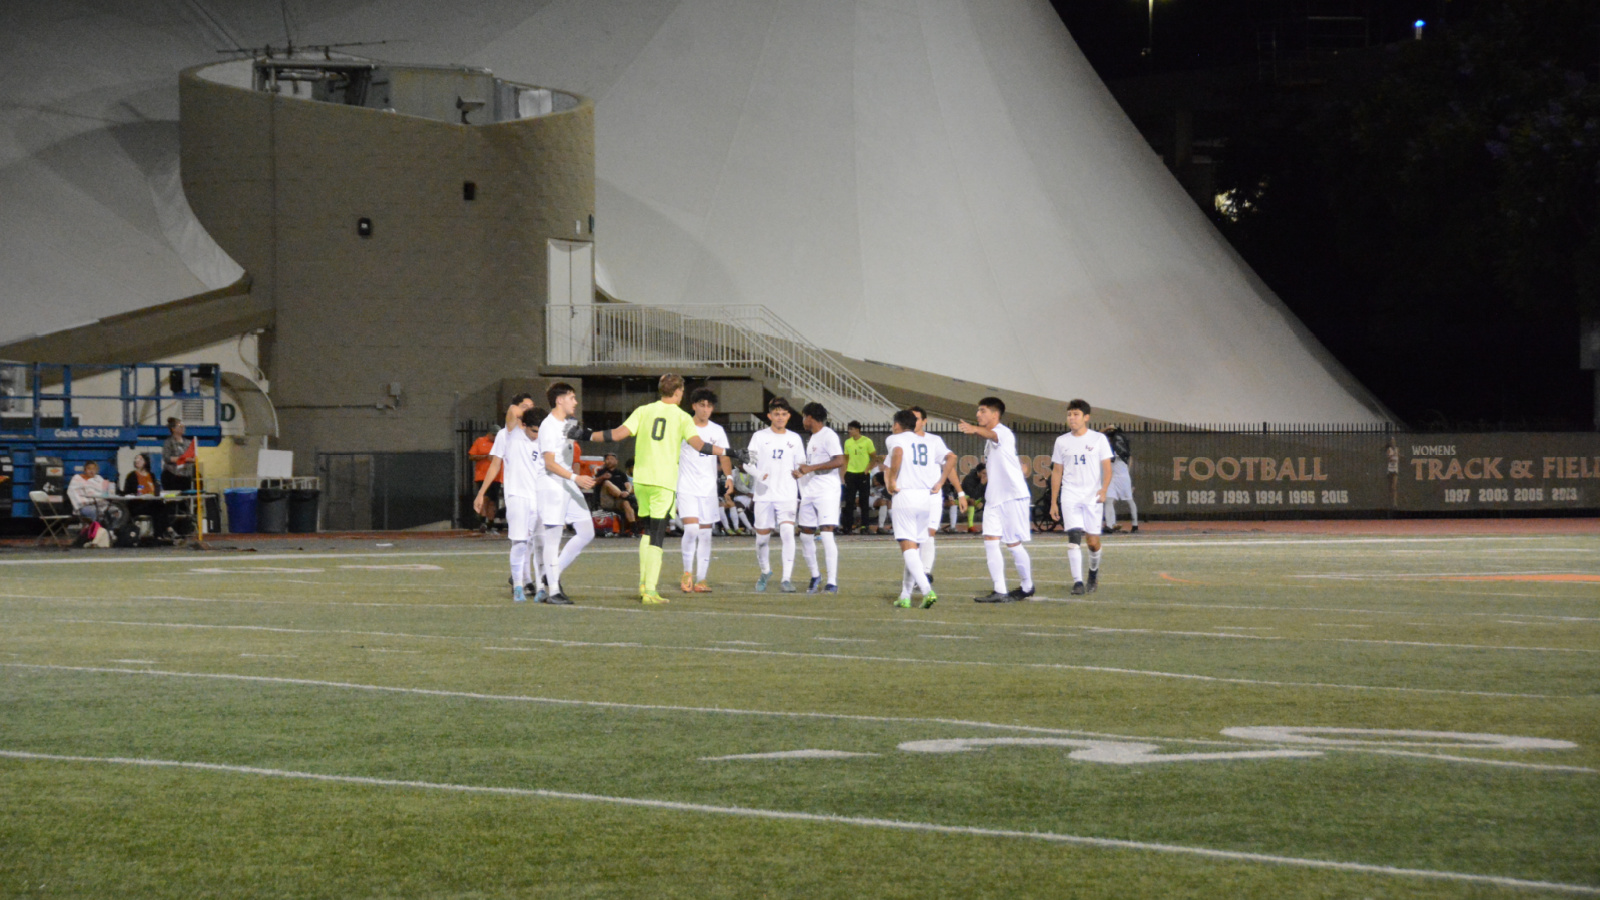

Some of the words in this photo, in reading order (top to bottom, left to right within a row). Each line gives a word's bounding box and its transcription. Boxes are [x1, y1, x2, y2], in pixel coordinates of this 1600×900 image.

[651, 417, 666, 441] 0
[772, 449, 784, 460] 17
[911, 442, 928, 466] 18
[1412, 445, 1457, 456] WOMENS
[1074, 454, 1086, 465] 14
[1172, 456, 1329, 481] FOOTBALL
[1411, 457, 1504, 481] TRACK
[1509, 460, 1534, 479] &
[1153, 490, 1180, 505] 1975
[1186, 490, 1216, 505] 1982
[1222, 490, 1250, 504] 1993
[1255, 490, 1283, 504] 1994
[1288, 490, 1316, 504] 1995
[1321, 490, 1349, 504] 2015
[1444, 489, 1471, 503] 1997
[1478, 488, 1509, 502] 2003
[1514, 488, 1543, 502] 2005
